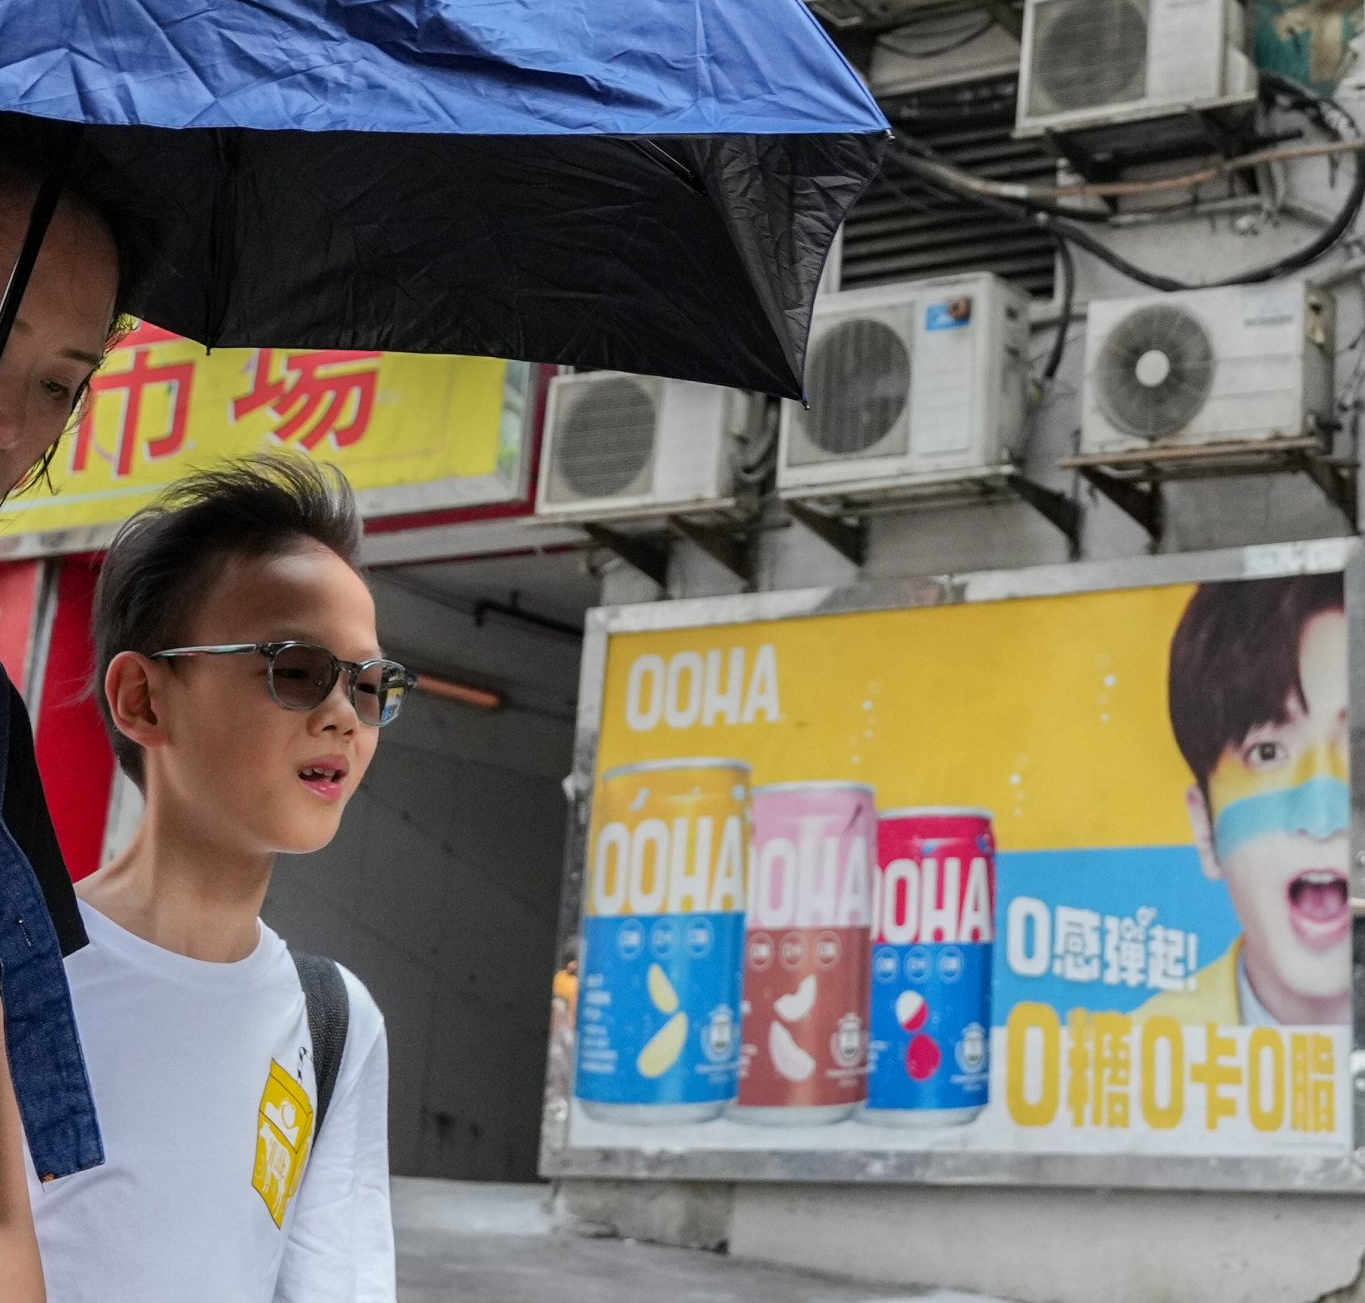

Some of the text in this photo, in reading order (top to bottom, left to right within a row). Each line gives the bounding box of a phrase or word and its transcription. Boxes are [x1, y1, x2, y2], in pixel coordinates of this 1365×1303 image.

[625, 643, 781, 732] OOHA
[594, 815, 745, 915] OOHA
[751, 836, 872, 929] OHA
